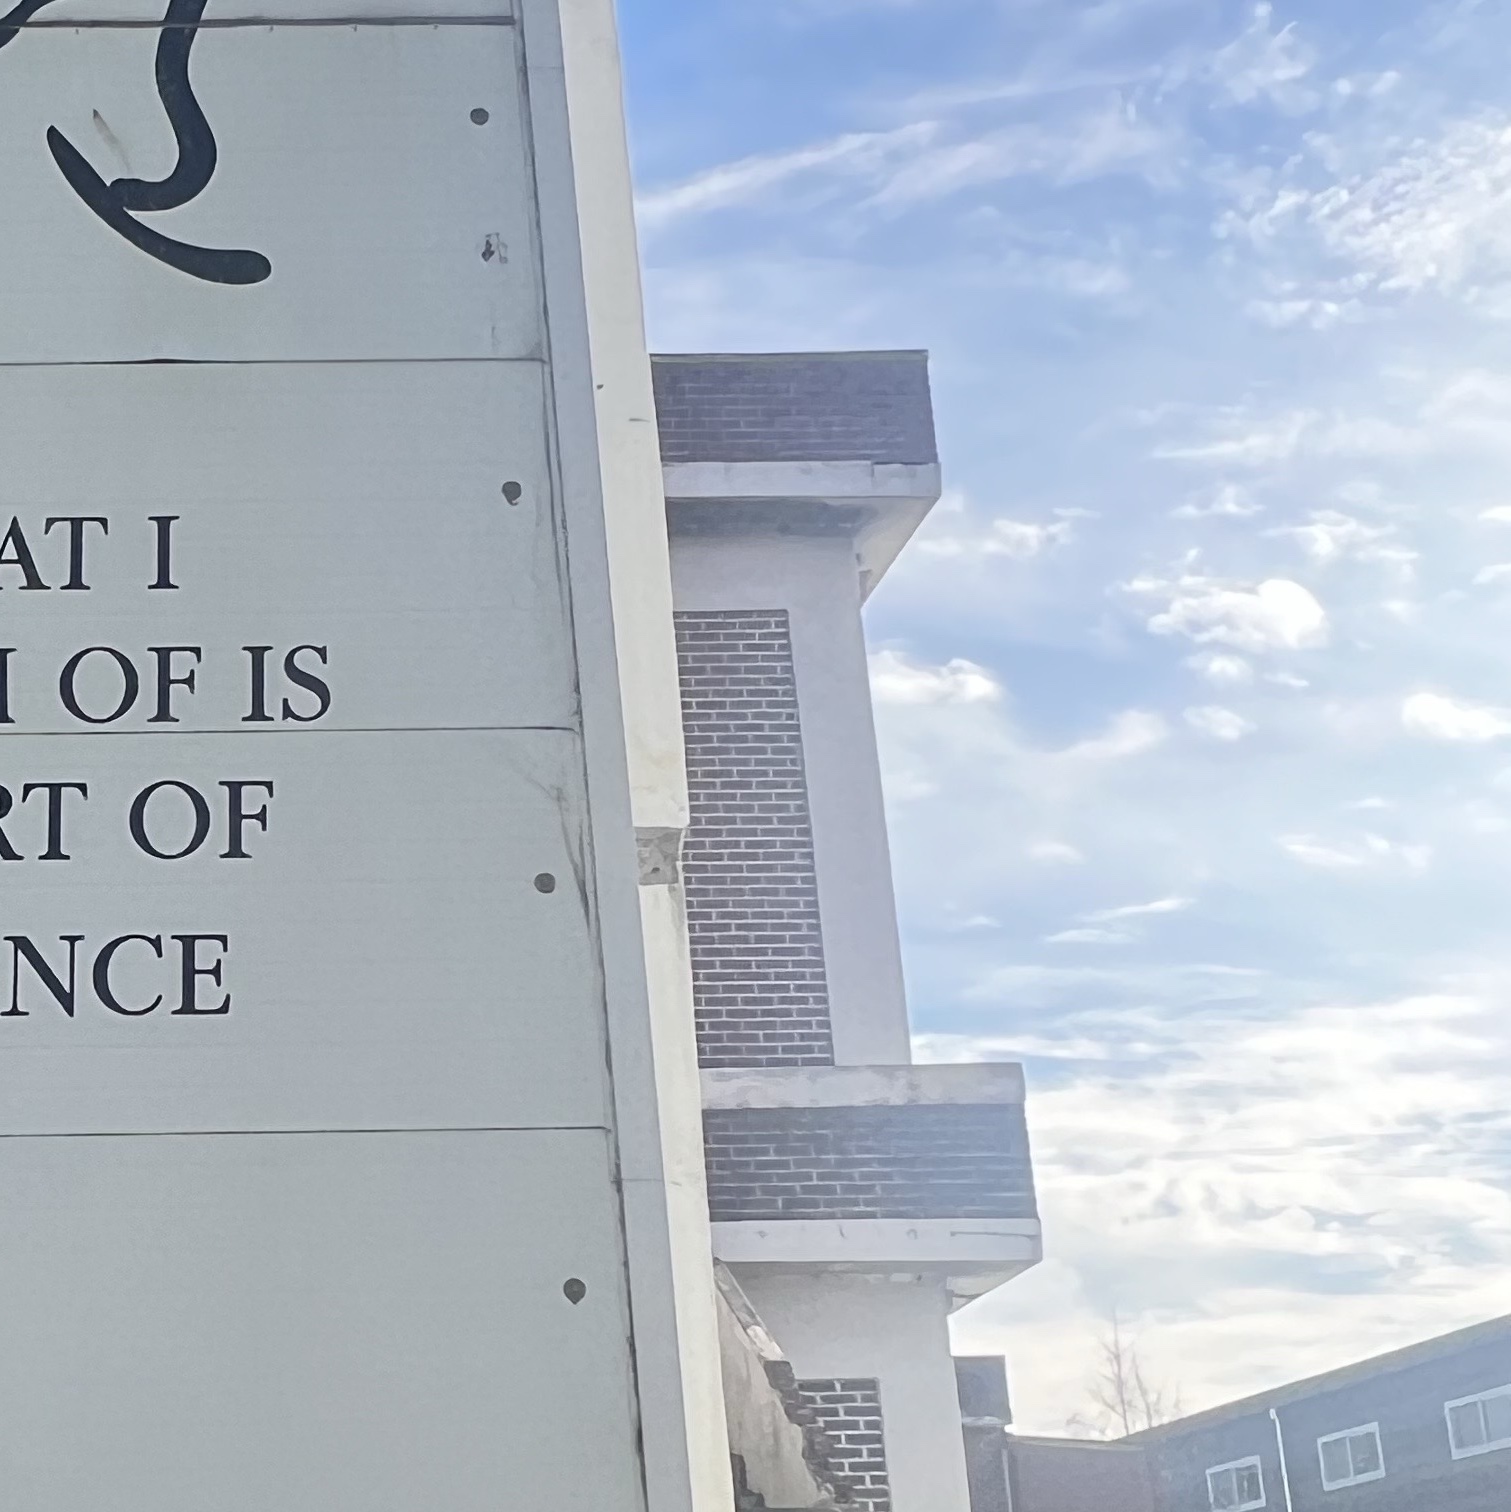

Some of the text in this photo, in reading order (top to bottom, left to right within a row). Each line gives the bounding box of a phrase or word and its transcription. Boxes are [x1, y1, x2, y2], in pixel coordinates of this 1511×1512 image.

[148, 515, 180, 590] I
[59, 646, 202, 724] OF
[241, 644, 331, 722] IS
[129, 780, 274, 860] OF
